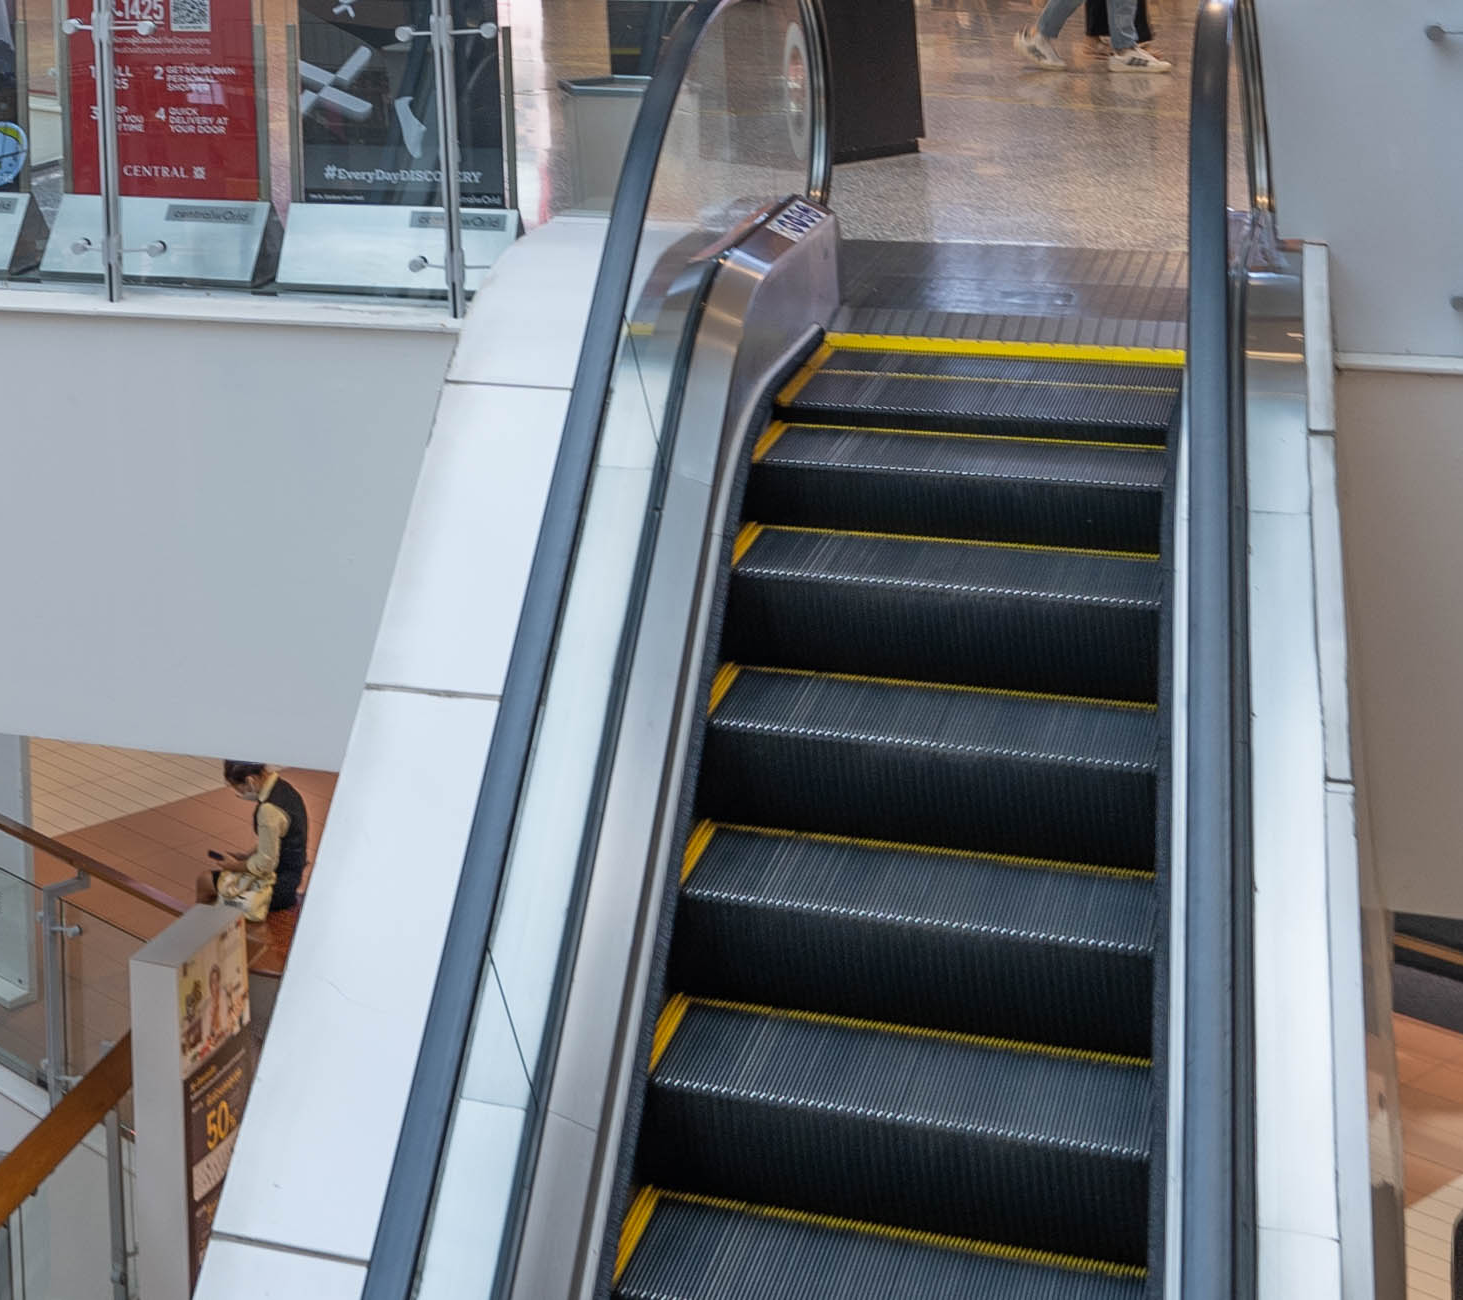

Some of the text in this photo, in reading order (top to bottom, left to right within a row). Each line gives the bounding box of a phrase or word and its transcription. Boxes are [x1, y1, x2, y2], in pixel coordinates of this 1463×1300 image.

[154, 66, 164, 80] 2
[155, 107, 166, 121] 4
[123, 166, 189, 179] CENTRAL
[324, 164, 483, 184] #EveryDayDISCOERY
